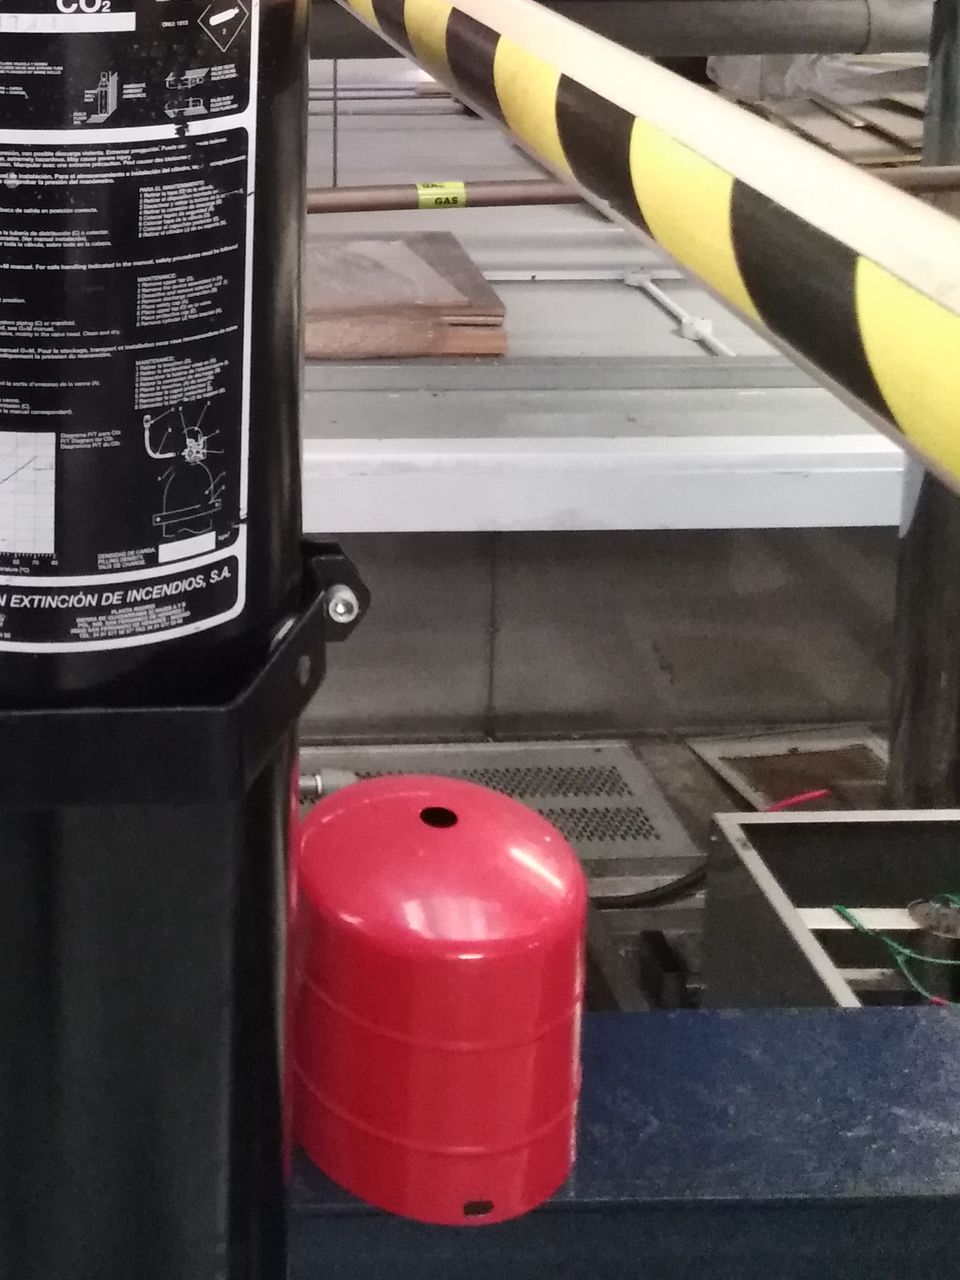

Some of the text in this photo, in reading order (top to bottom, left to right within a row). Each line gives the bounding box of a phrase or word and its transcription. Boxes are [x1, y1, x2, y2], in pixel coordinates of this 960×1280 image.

[435, 196, 459, 205] GAS
[9, 592, 99, 608] EXTINCIÓN
[101, 591, 124, 606] DE
[126, 574, 207, 603] INCENDIOS,
